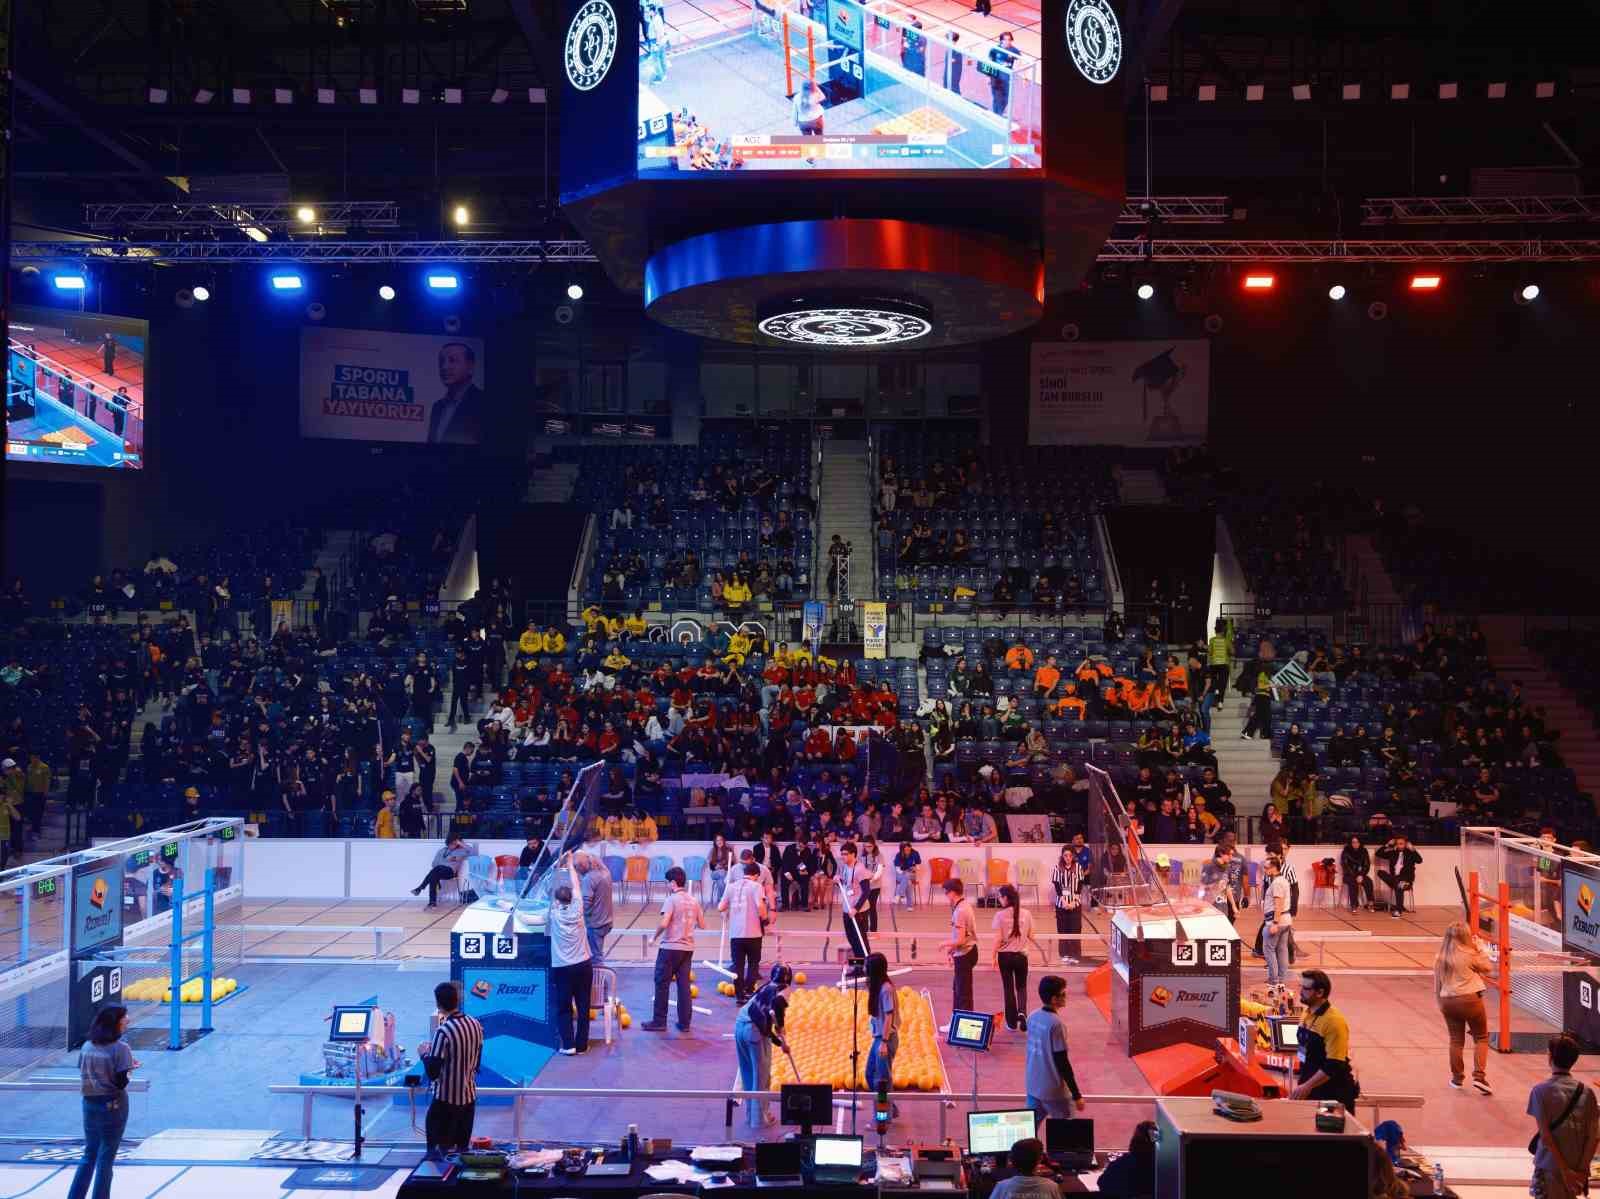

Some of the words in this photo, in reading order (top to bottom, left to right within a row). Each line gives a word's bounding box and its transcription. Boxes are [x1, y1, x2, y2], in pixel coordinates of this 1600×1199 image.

[340, 366, 399, 385] SPORU
[335, 384, 407, 401] TABANA
[326, 399, 423, 420] YAYIYORUZ
[496, 983, 540, 996] REBUILT
[1175, 990, 1220, 1003] REBUILT
